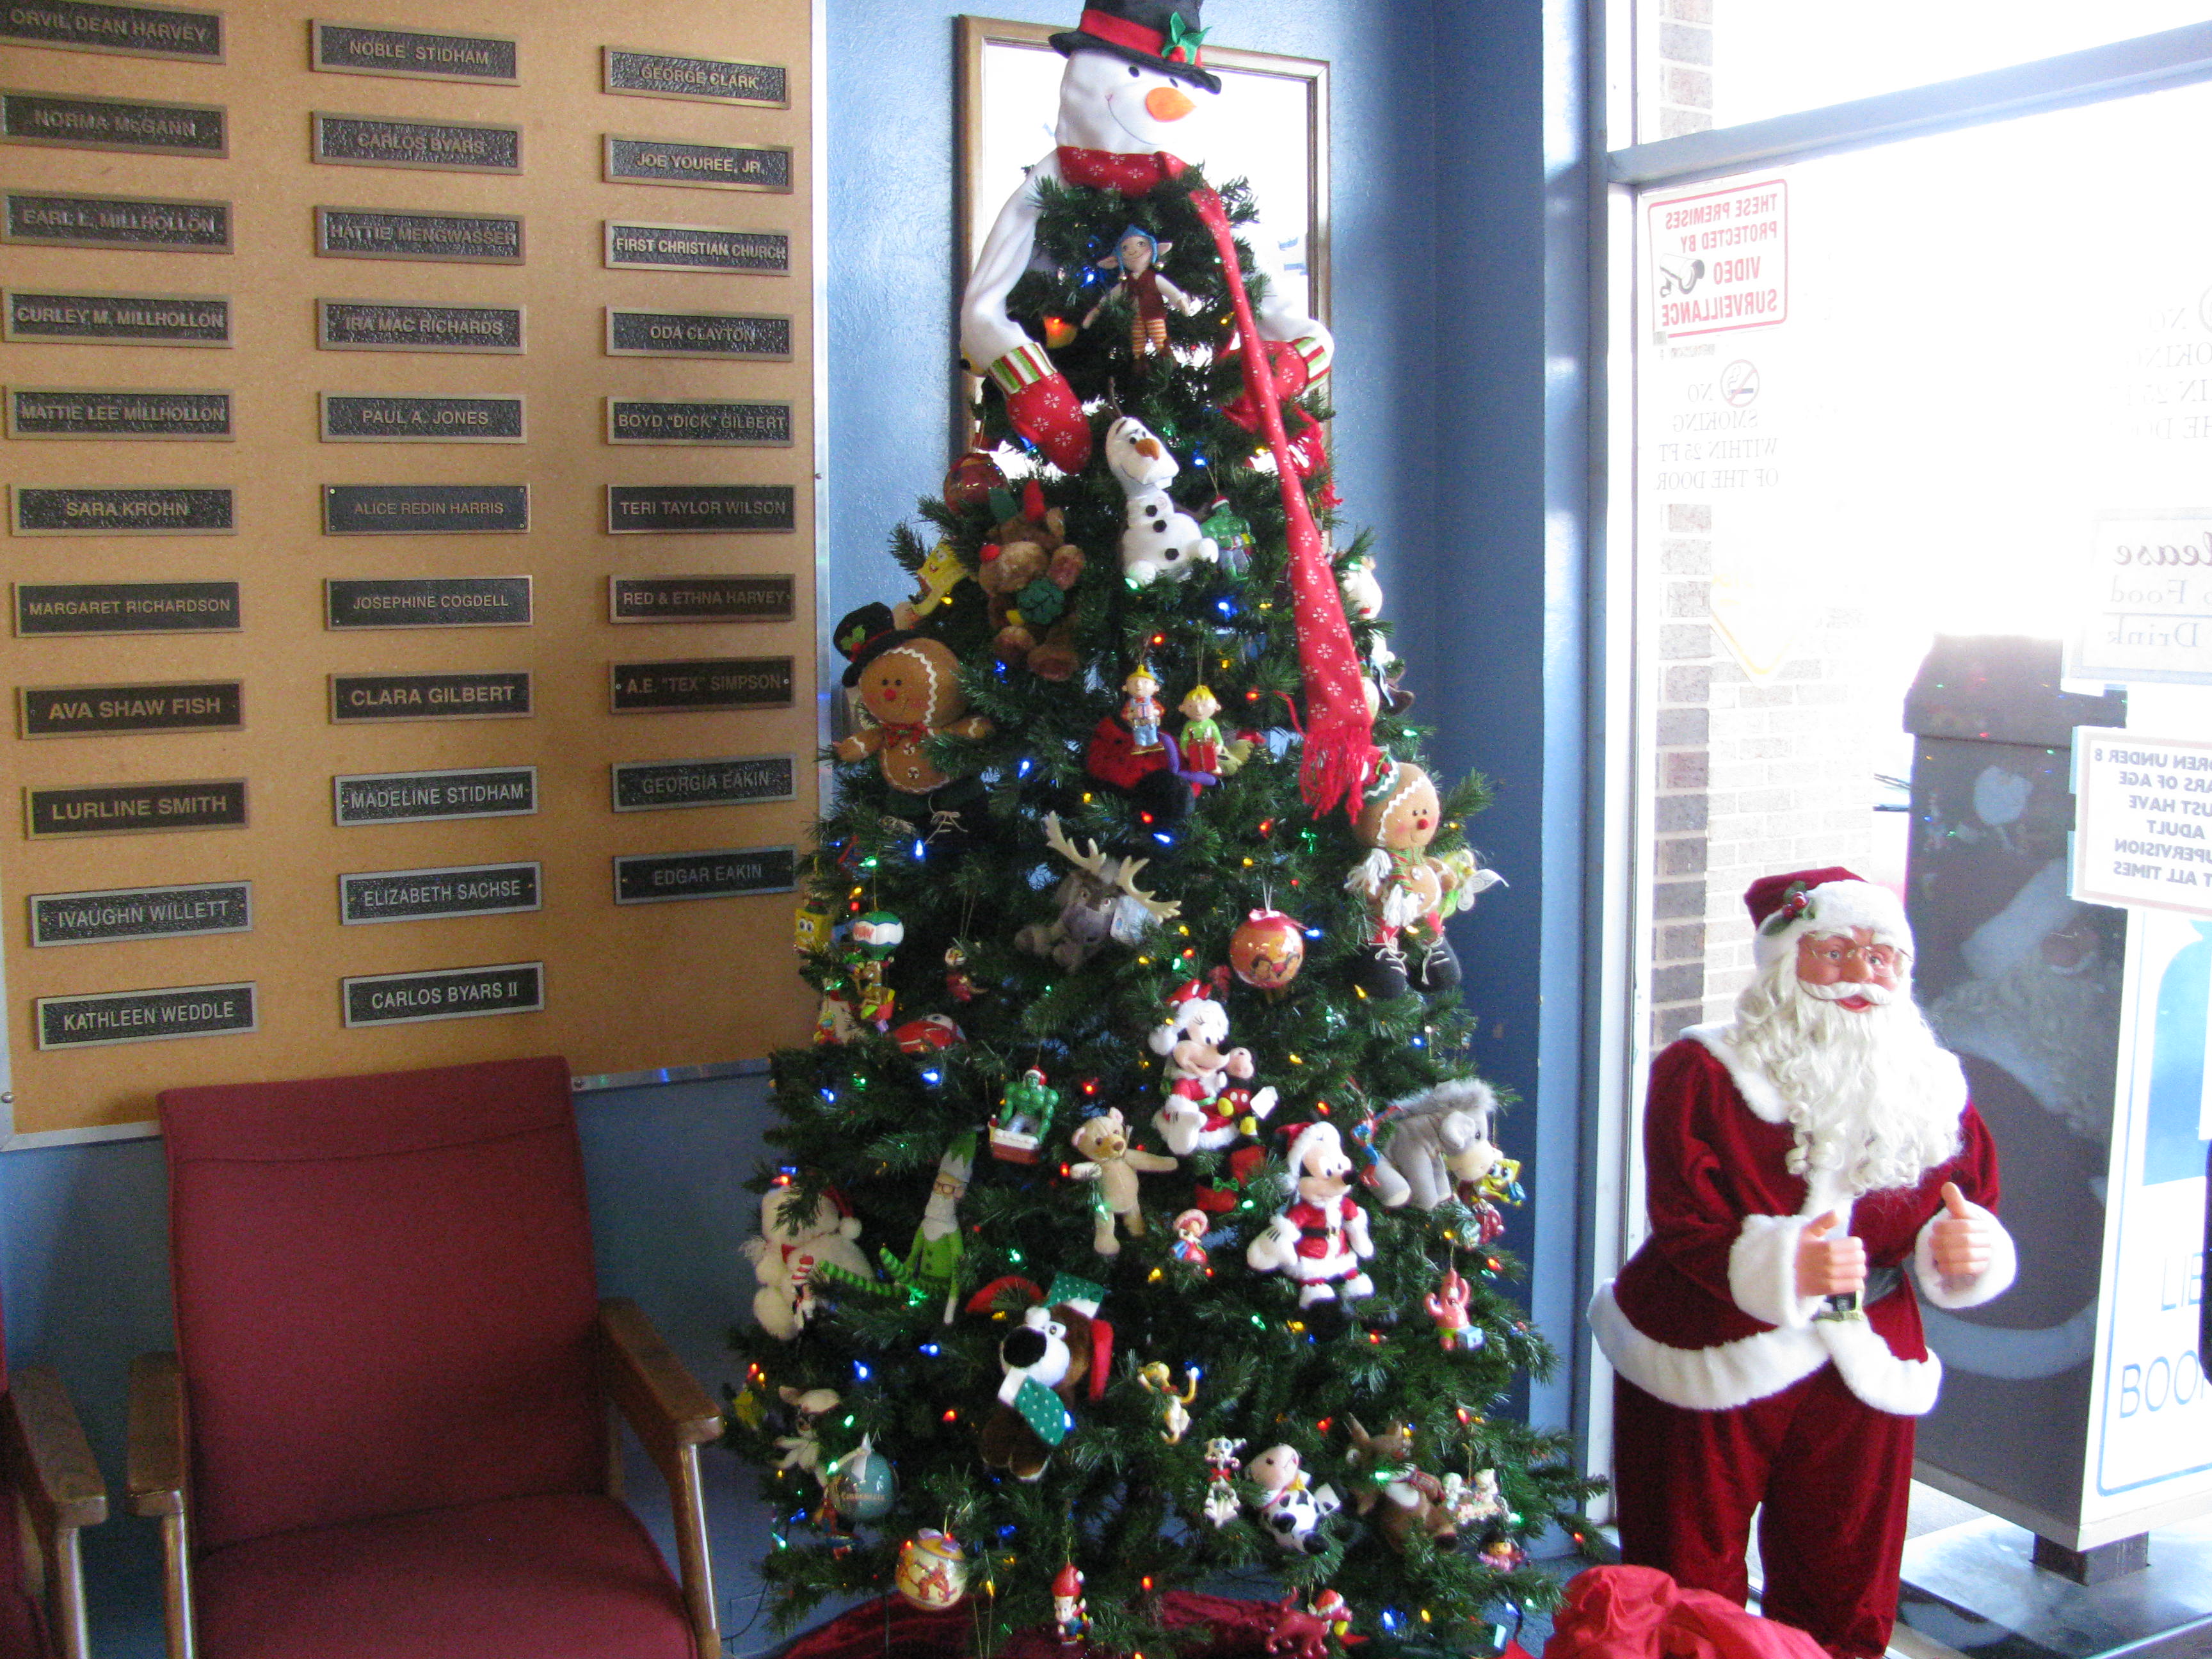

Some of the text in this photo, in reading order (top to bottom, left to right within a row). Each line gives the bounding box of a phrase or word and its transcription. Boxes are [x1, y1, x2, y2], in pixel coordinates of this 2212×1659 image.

[9, 8, 206, 41] ORVIL DEAN HARVEY
[349, 41, 488, 65] NOBLE STIDHAM
[641, 67, 759, 89] GEORGE CLARK
[34, 109, 108, 130] NORMA
[357, 133, 485, 154] CARLOS BYARS
[637, 154, 666, 168] JOE
[22, 209, 72, 226] EARL
[100, 212, 215, 233] MILLHOLLON
[331, 225, 517, 246] HATTIE MENGWASSER
[616, 238, 786, 260] FIRST CHRISTIAN CHURCH
[17, 308, 89, 324] CURLEY
[117, 311, 225, 328] MILLHOLLON
[346, 317, 502, 335] IRA MAC RICHARDS
[650, 326, 755, 342] ODA CLAYTON
[21, 405, 225, 422] MATTIE LEE MILLHOLLON
[363, 410, 406, 424] PAUL
[433, 411, 489, 426] JONES
[618, 414, 662, 428] BOYD
[720, 417, 785, 429] GILBERT
[66, 502, 189, 517] SARA KROHN
[354, 502, 504, 515] ALICE REDIN HARRIS
[620, 501, 786, 515] TERI TAYLOR WILSON
[29, 599, 230, 616] MARGARET RICHARDSON
[353, 595, 509, 610] JOSEPHINE COGDELL
[623, 591, 785, 605] RED & ETHNA HARVEY
[710, 675, 781, 691] SIMPSON
[351, 685, 515, 706] CLARA GILBERT
[49, 697, 221, 720] AVA SHAW FISH
[642, 771, 769, 794] GEORGIA EAKIN
[351, 783, 524, 809] MADELINE STIDHAM
[52, 796, 227, 821] LURLINE SMITH
[653, 865, 762, 886] EDGAR EAKIN
[364, 880, 520, 907] ELIZABETH SACHSE
[59, 901, 229, 928] IVAUGHN WILLETT
[371, 982, 518, 1009] CARLOS BYARS II
[63, 1001, 234, 1031] KATHLEEN WEDDLE
[2119, 1349, 2206, 1419] BOO
